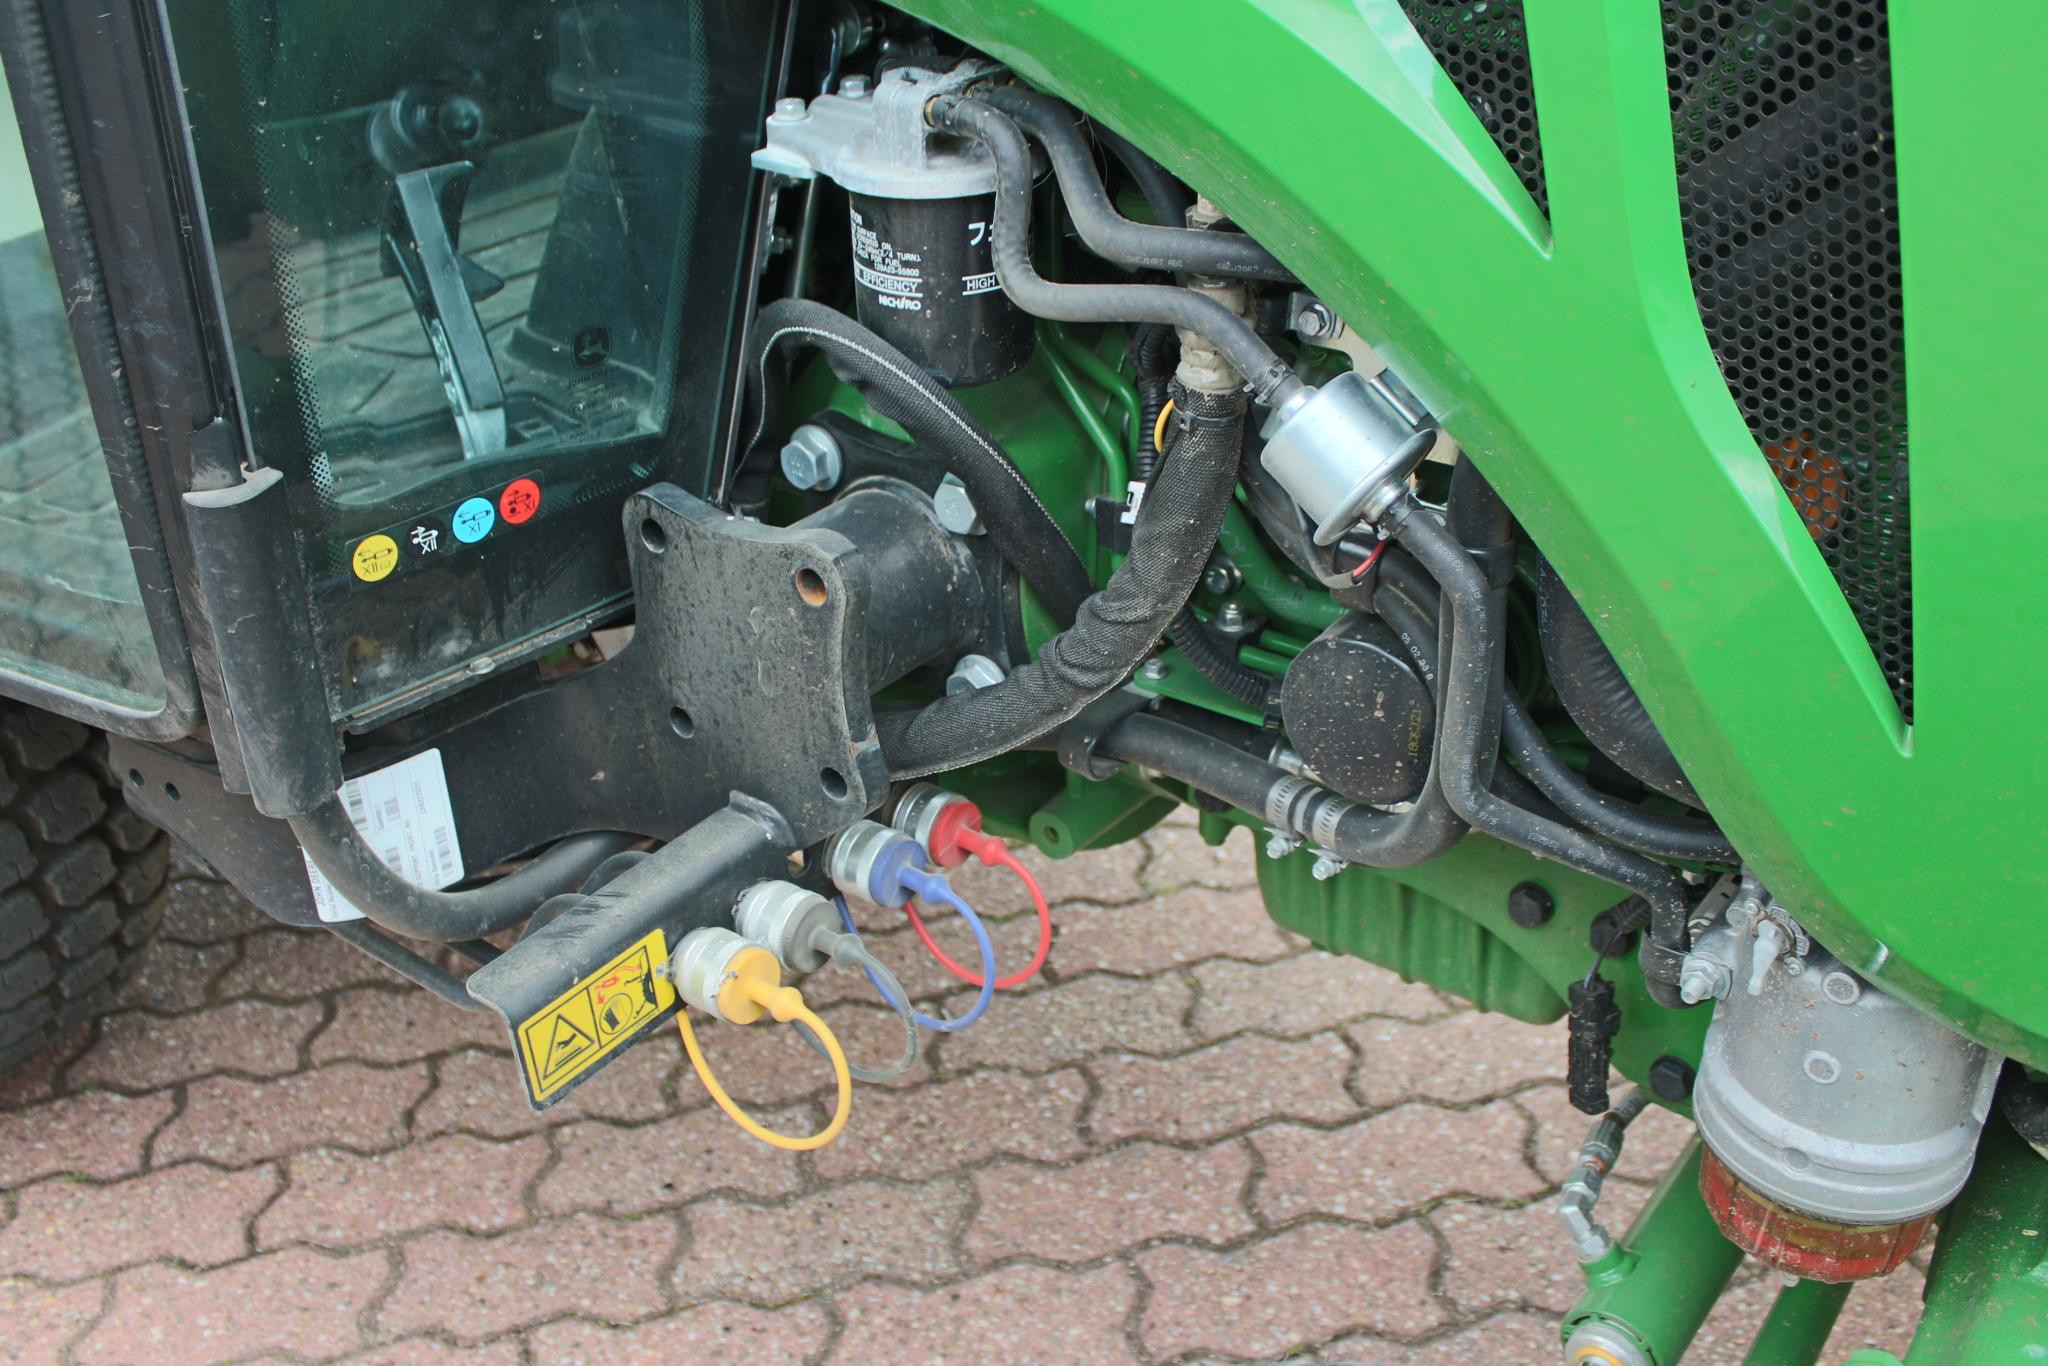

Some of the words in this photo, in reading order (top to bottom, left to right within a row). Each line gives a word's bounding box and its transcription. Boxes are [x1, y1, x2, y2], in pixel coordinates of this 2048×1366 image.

[968, 221, 993, 246] フ
[863, 271, 917, 292] EFFICIENCY
[967, 276, 995, 291] HIGH
[420, 538, 438, 555] XII
[1410, 645, 1420, 657] 02
